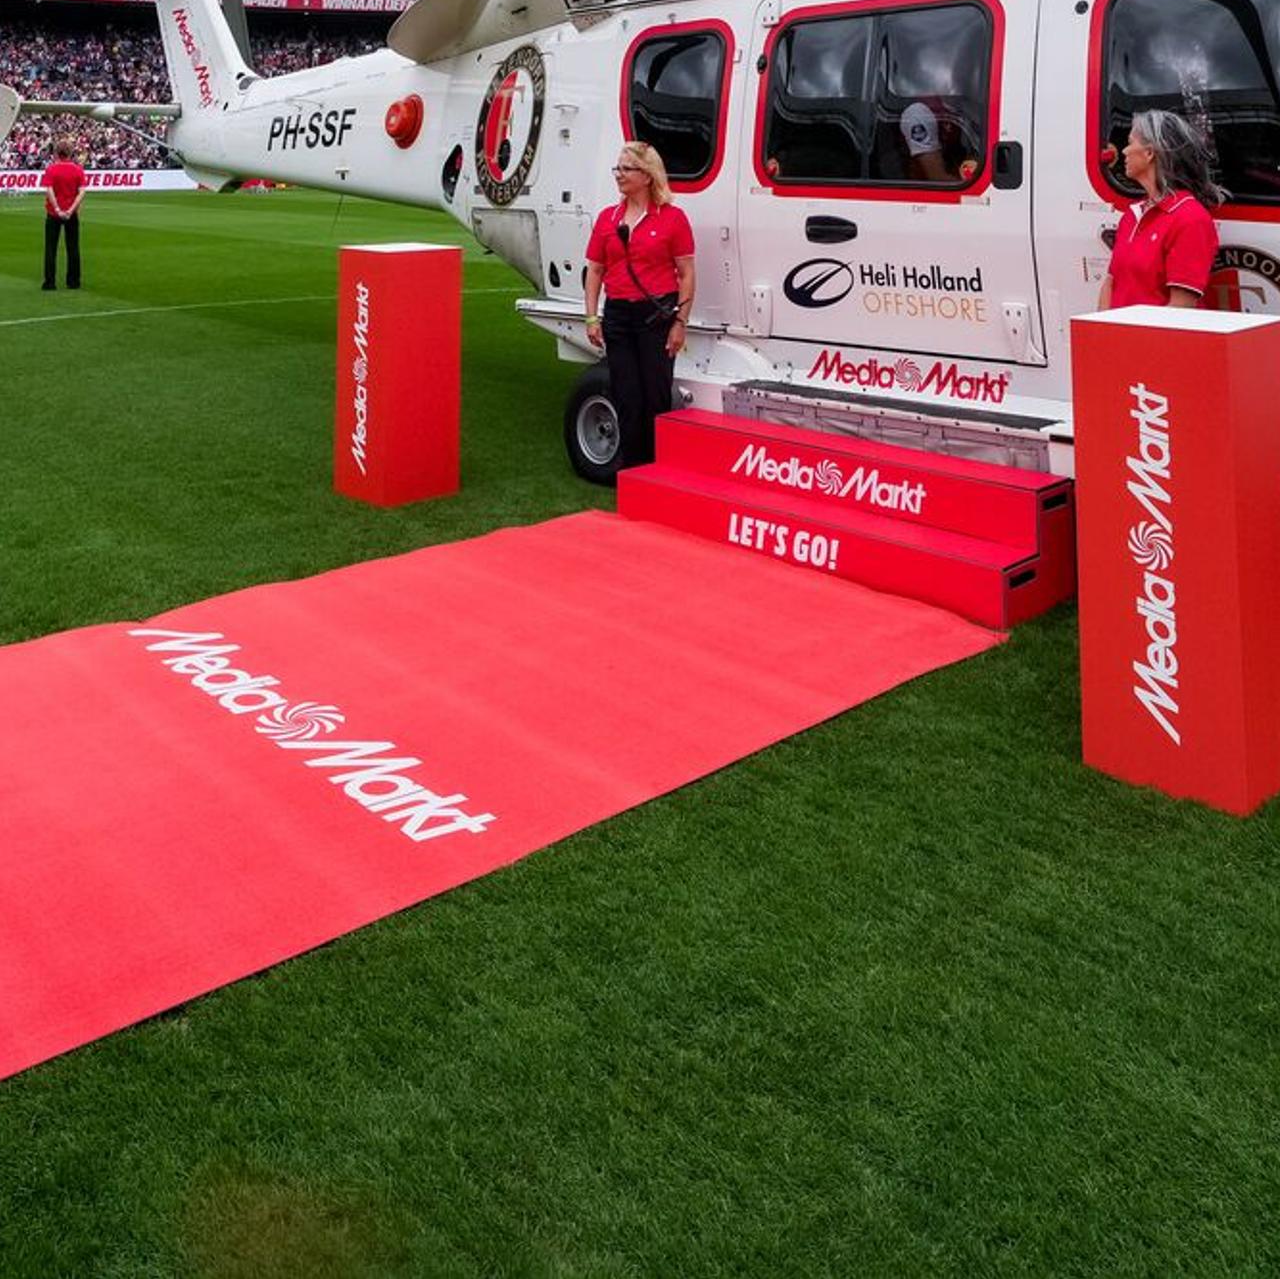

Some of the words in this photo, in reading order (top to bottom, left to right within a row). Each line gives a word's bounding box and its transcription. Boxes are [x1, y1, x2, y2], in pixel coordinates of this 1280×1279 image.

[267, 107, 357, 151] PH-SSF
[102, 173, 144, 187] DEALS
[859, 263, 896, 287] Heli
[903, 266, 983, 293] Holland
[862, 292, 988, 322] OFFSHORE
[352, 281, 370, 363] Markt
[806, 349, 896, 389] Media
[916, 361, 1009, 404] Markt
[350, 386, 368, 476] Media
[1125, 382, 1173, 536] Markt
[730, 443, 815, 491] Media
[839, 466, 927, 515] Markt
[727, 512, 789, 557] LET'S
[792, 530, 840, 570] GO!
[1132, 570, 1181, 747] Media
[126, 628, 288, 715] Media
[273, 740, 497, 842] Markt
